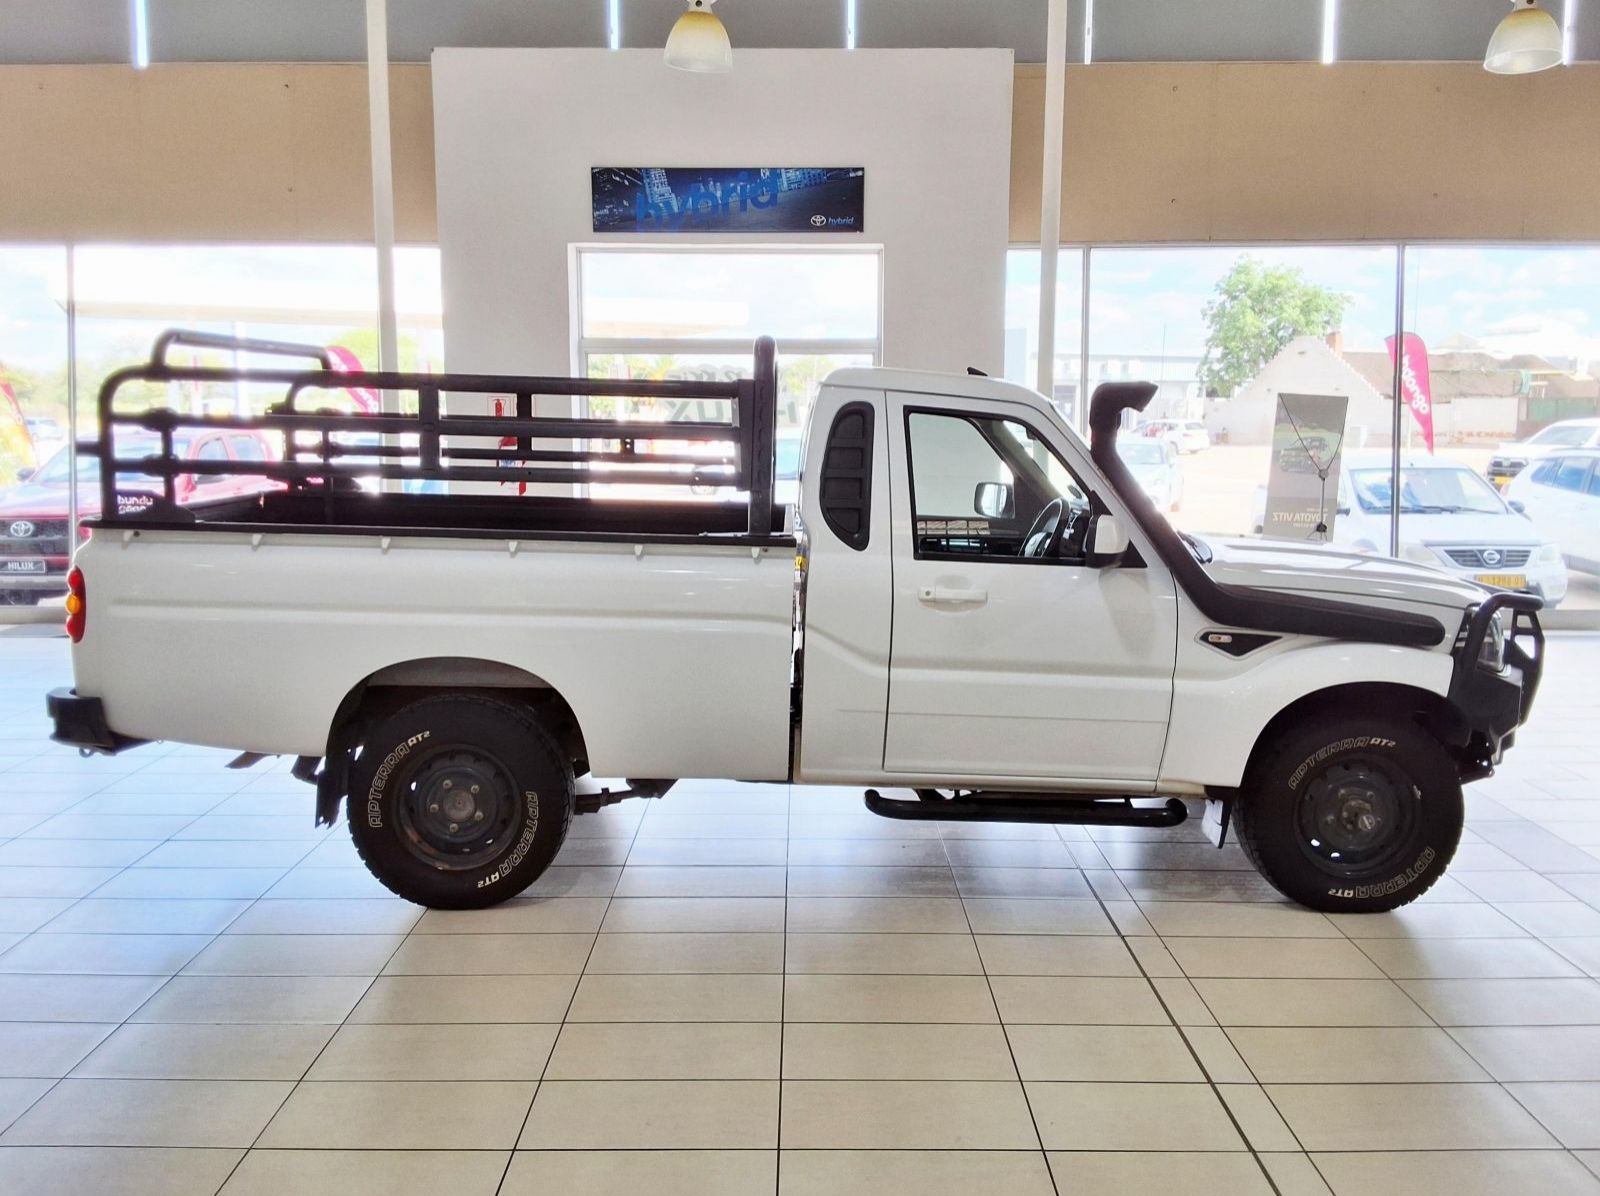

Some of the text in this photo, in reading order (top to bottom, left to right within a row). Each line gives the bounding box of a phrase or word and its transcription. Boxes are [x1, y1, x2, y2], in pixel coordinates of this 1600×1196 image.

[828, 216, 855, 226] hybrid
[8, 561, 34, 570] HILUX
[367, 742, 410, 828] APTERRA
[1288, 736, 1370, 790] APTERRA
[499, 790, 539, 877] APTERRA
[1355, 846, 1435, 898] APTERRA
